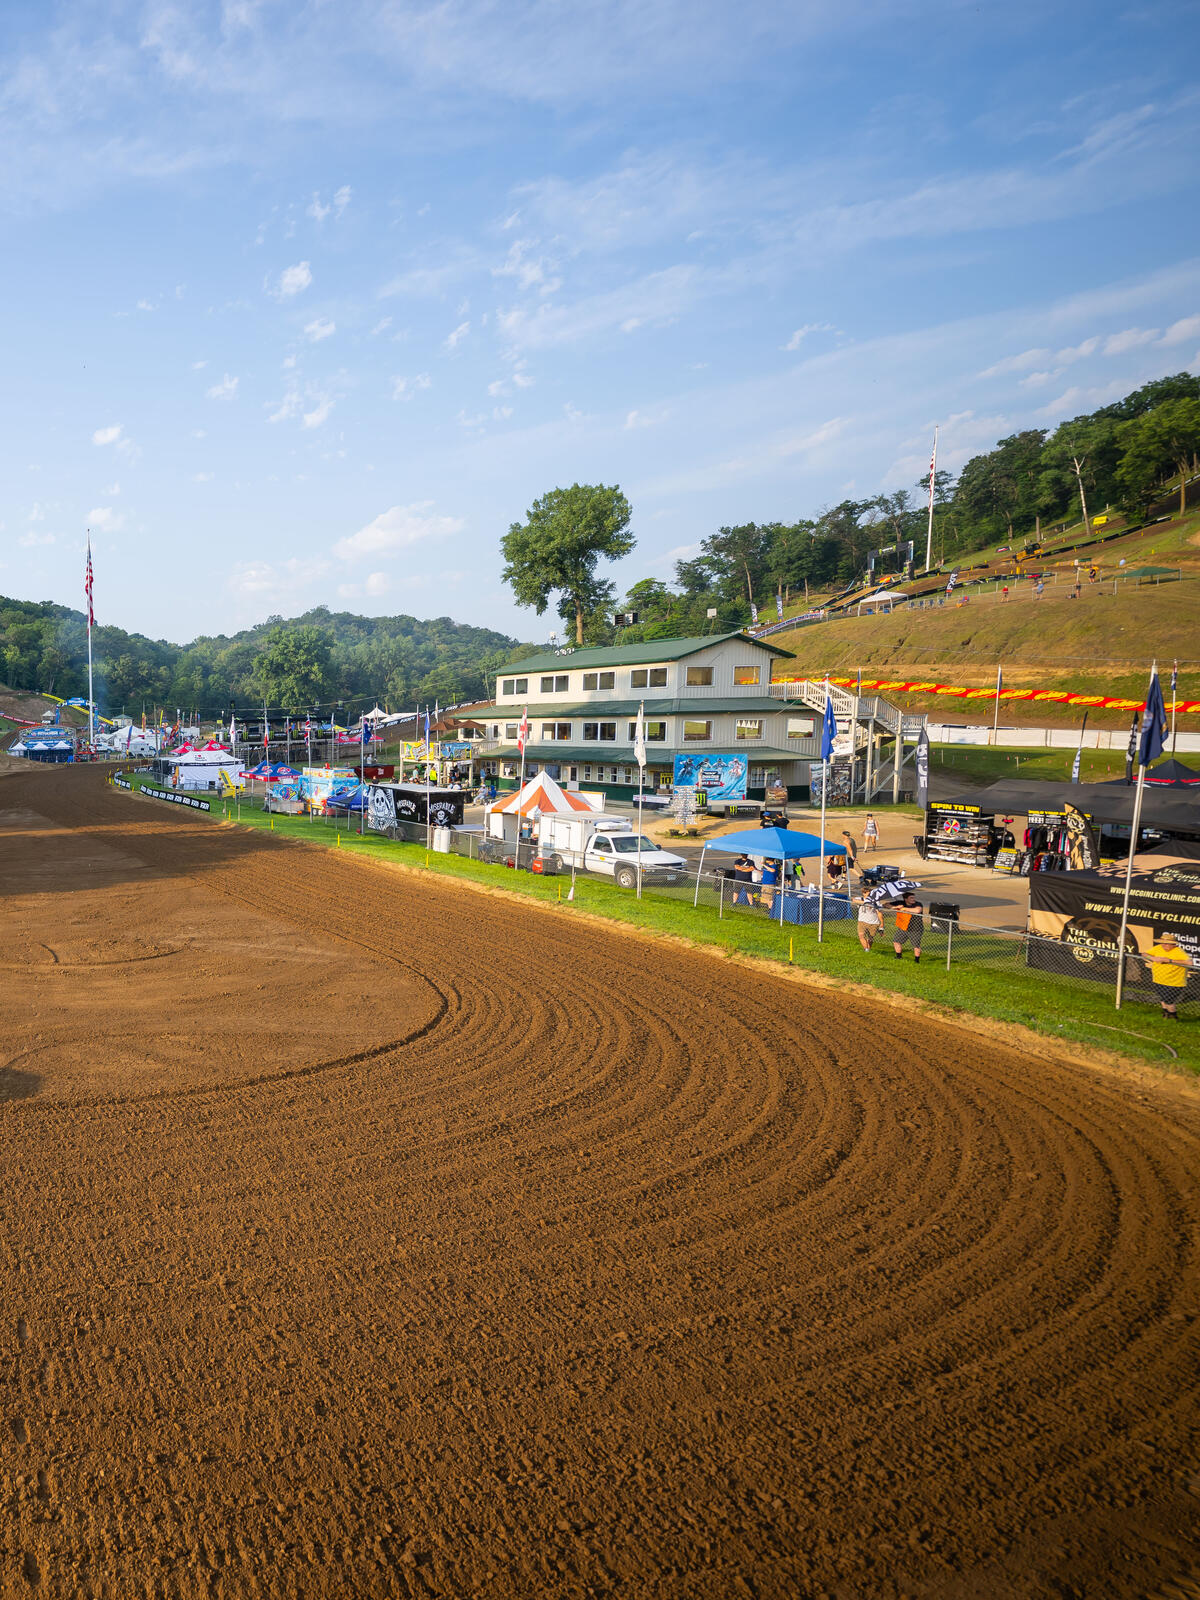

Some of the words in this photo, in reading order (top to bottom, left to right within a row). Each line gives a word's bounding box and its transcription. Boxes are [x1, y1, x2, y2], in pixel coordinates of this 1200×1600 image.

[965, 805, 980, 813] WIN
[1110, 886, 1200, 904] WWWMCGINLEYCLINIC.CO
[1067, 927, 1089, 937] THE
[1162, 931, 1198, 943] icial
